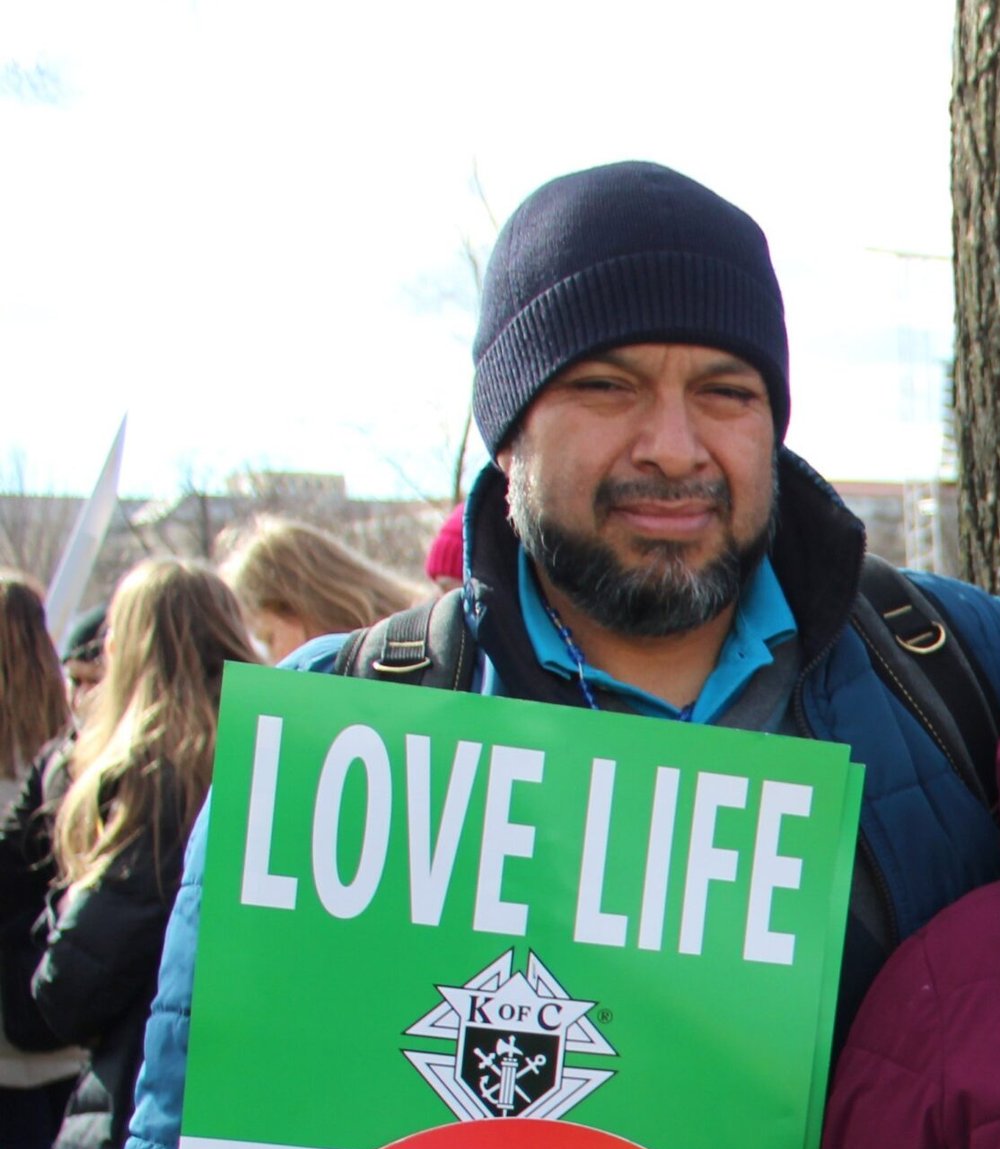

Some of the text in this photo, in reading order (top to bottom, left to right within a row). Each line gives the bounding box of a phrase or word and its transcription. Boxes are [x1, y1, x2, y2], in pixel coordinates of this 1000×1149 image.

[240, 714, 813, 965] LOVE LIFE
[468, 995, 563, 1031] K OF C
